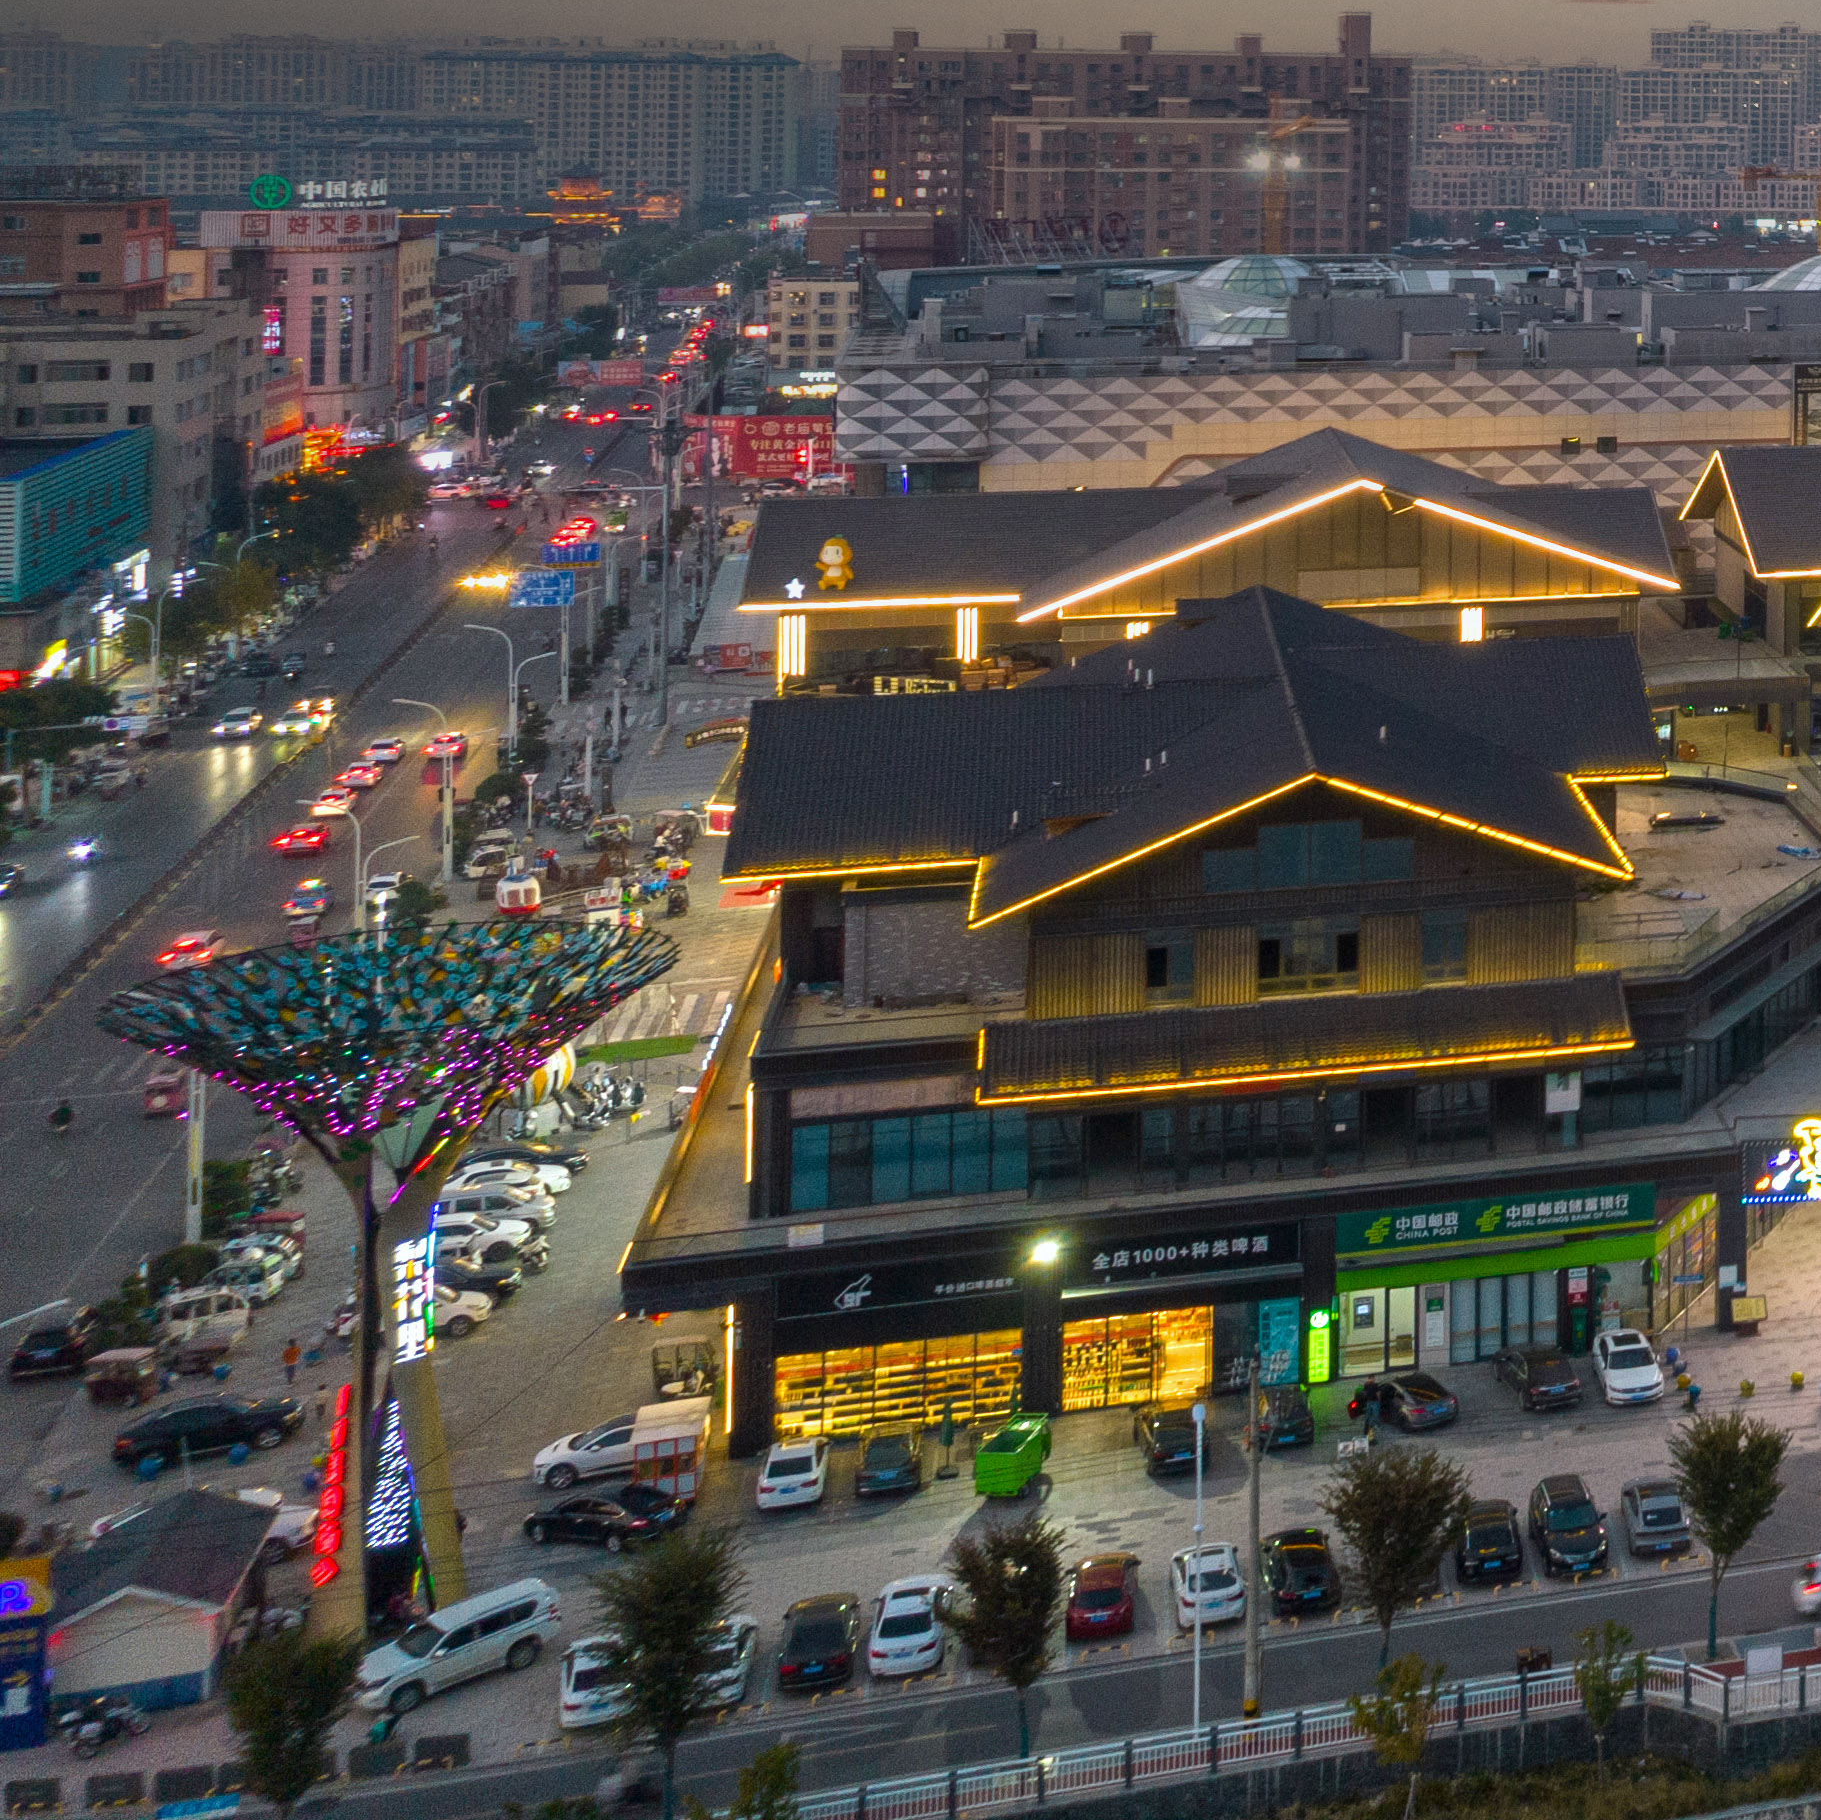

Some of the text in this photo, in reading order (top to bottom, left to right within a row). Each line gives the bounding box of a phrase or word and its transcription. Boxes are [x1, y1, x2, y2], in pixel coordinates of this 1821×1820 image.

[1506, 1193, 1630, 1220] 中国邮政储蓄银行
[1395, 1211, 1459, 1231] 中国邮政
[1395, 1226, 1459, 1240] CHINA POST
[1092, 1235, 1269, 1271] 全店1000+种类啤酒
